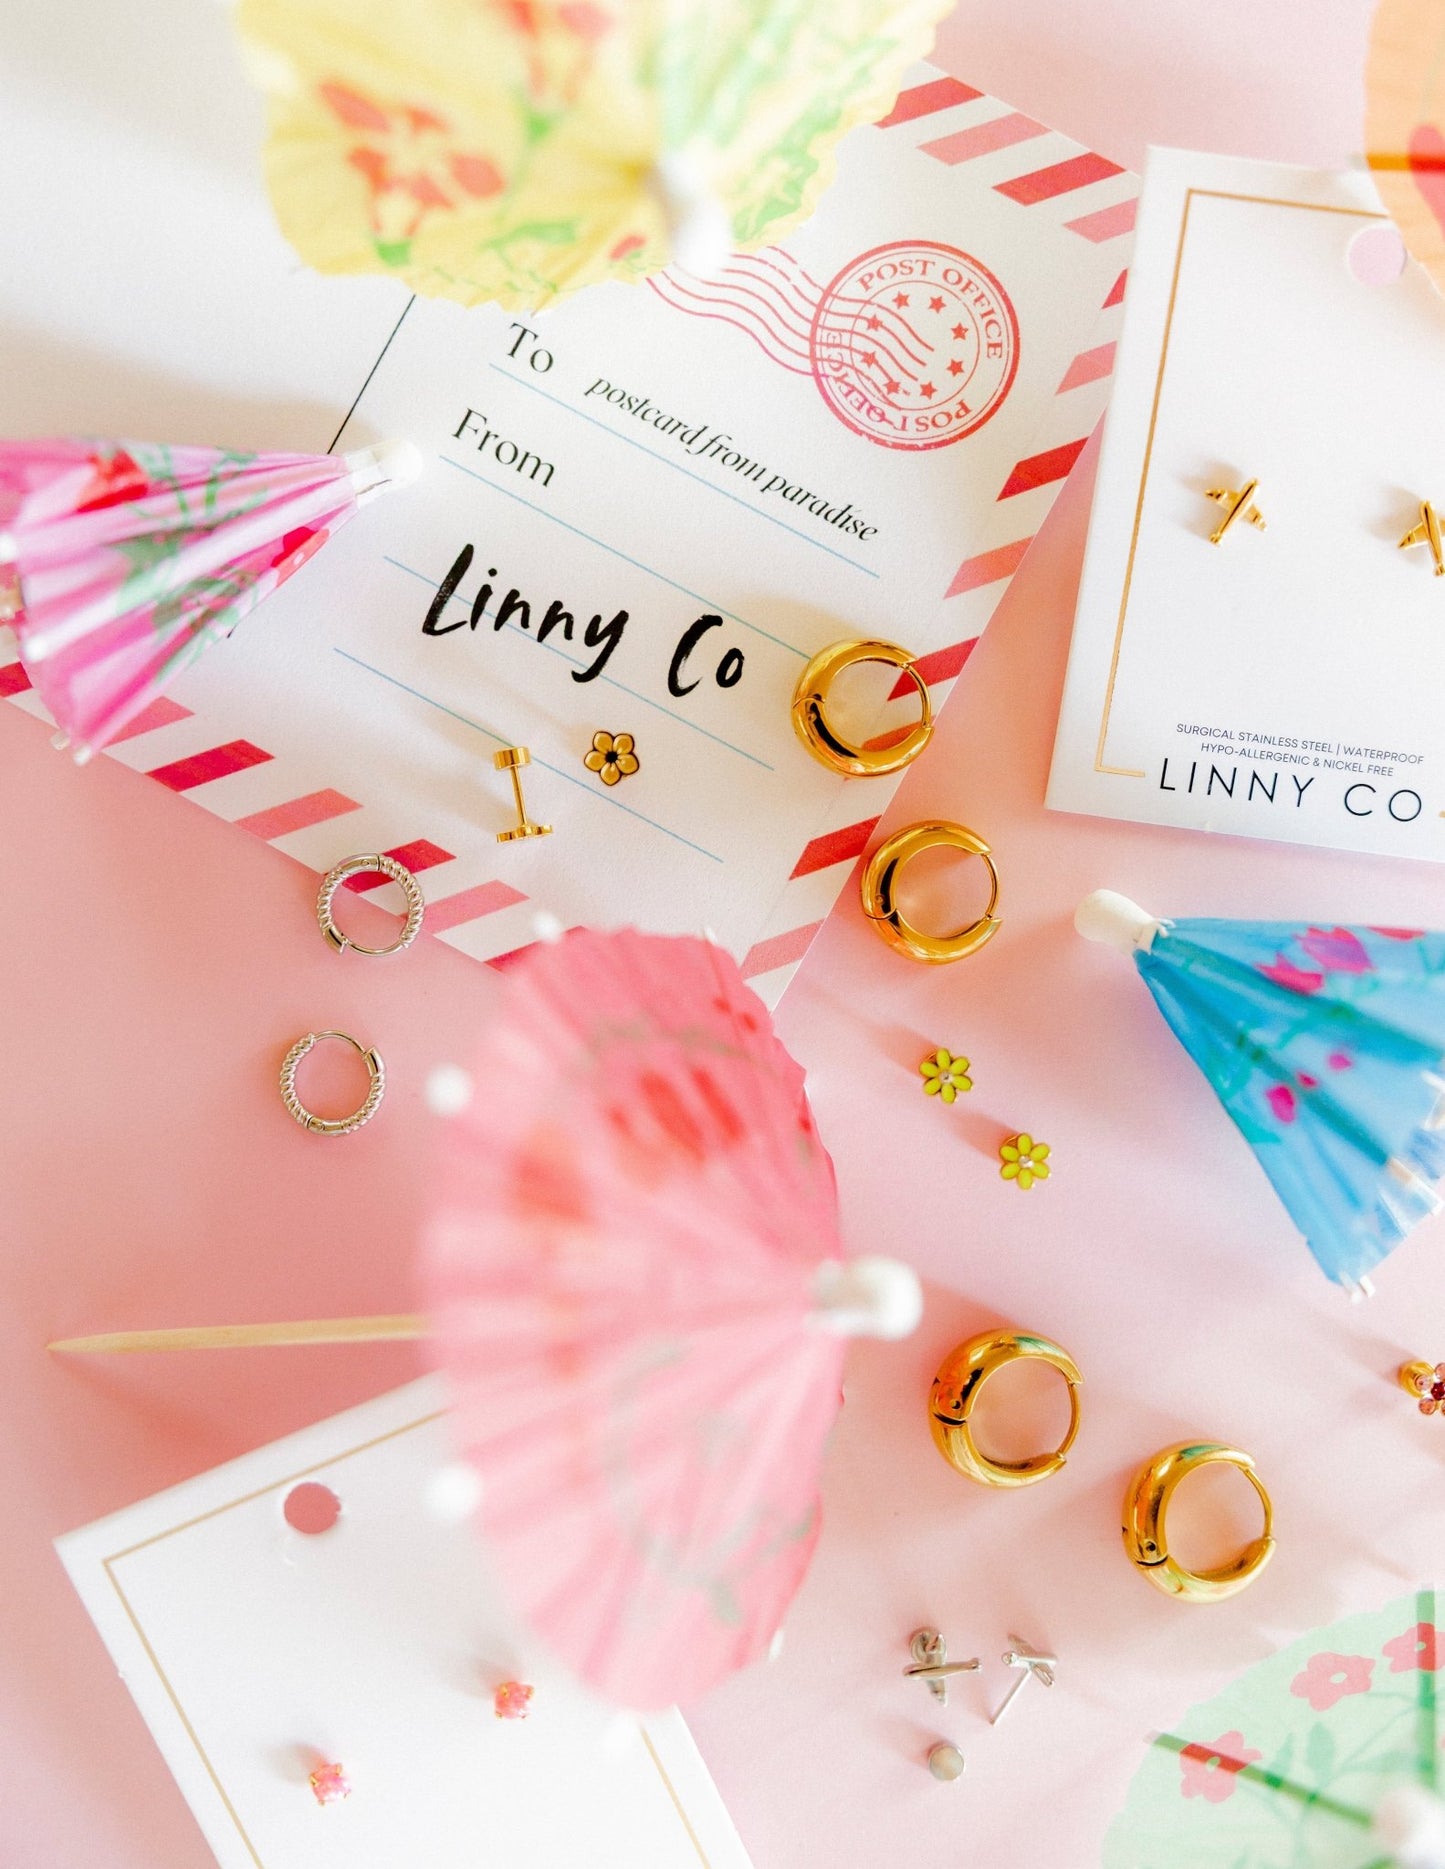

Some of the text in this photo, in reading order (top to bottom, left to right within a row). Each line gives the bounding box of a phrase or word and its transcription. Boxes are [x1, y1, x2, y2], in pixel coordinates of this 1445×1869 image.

[856, 259, 1003, 359] POST OFFICE
[505, 322, 553, 374] To
[451, 408, 556, 488] From
[893, 399, 972, 433] POST
[584, 377, 880, 542] postcard from paradise
[422, 543, 745, 697] Linny Co
[1176, 723, 1235, 740] SURGICAL
[1238, 731, 1298, 749] STAINLESS
[1301, 740, 1333, 754] STEEL
[1343, 746, 1425, 765] WATERPROOF
[1200, 742, 1394, 777] HYPO-ALLERGENIC & NICKEL FREE
[1159, 757, 1422, 822] LINNY CO
